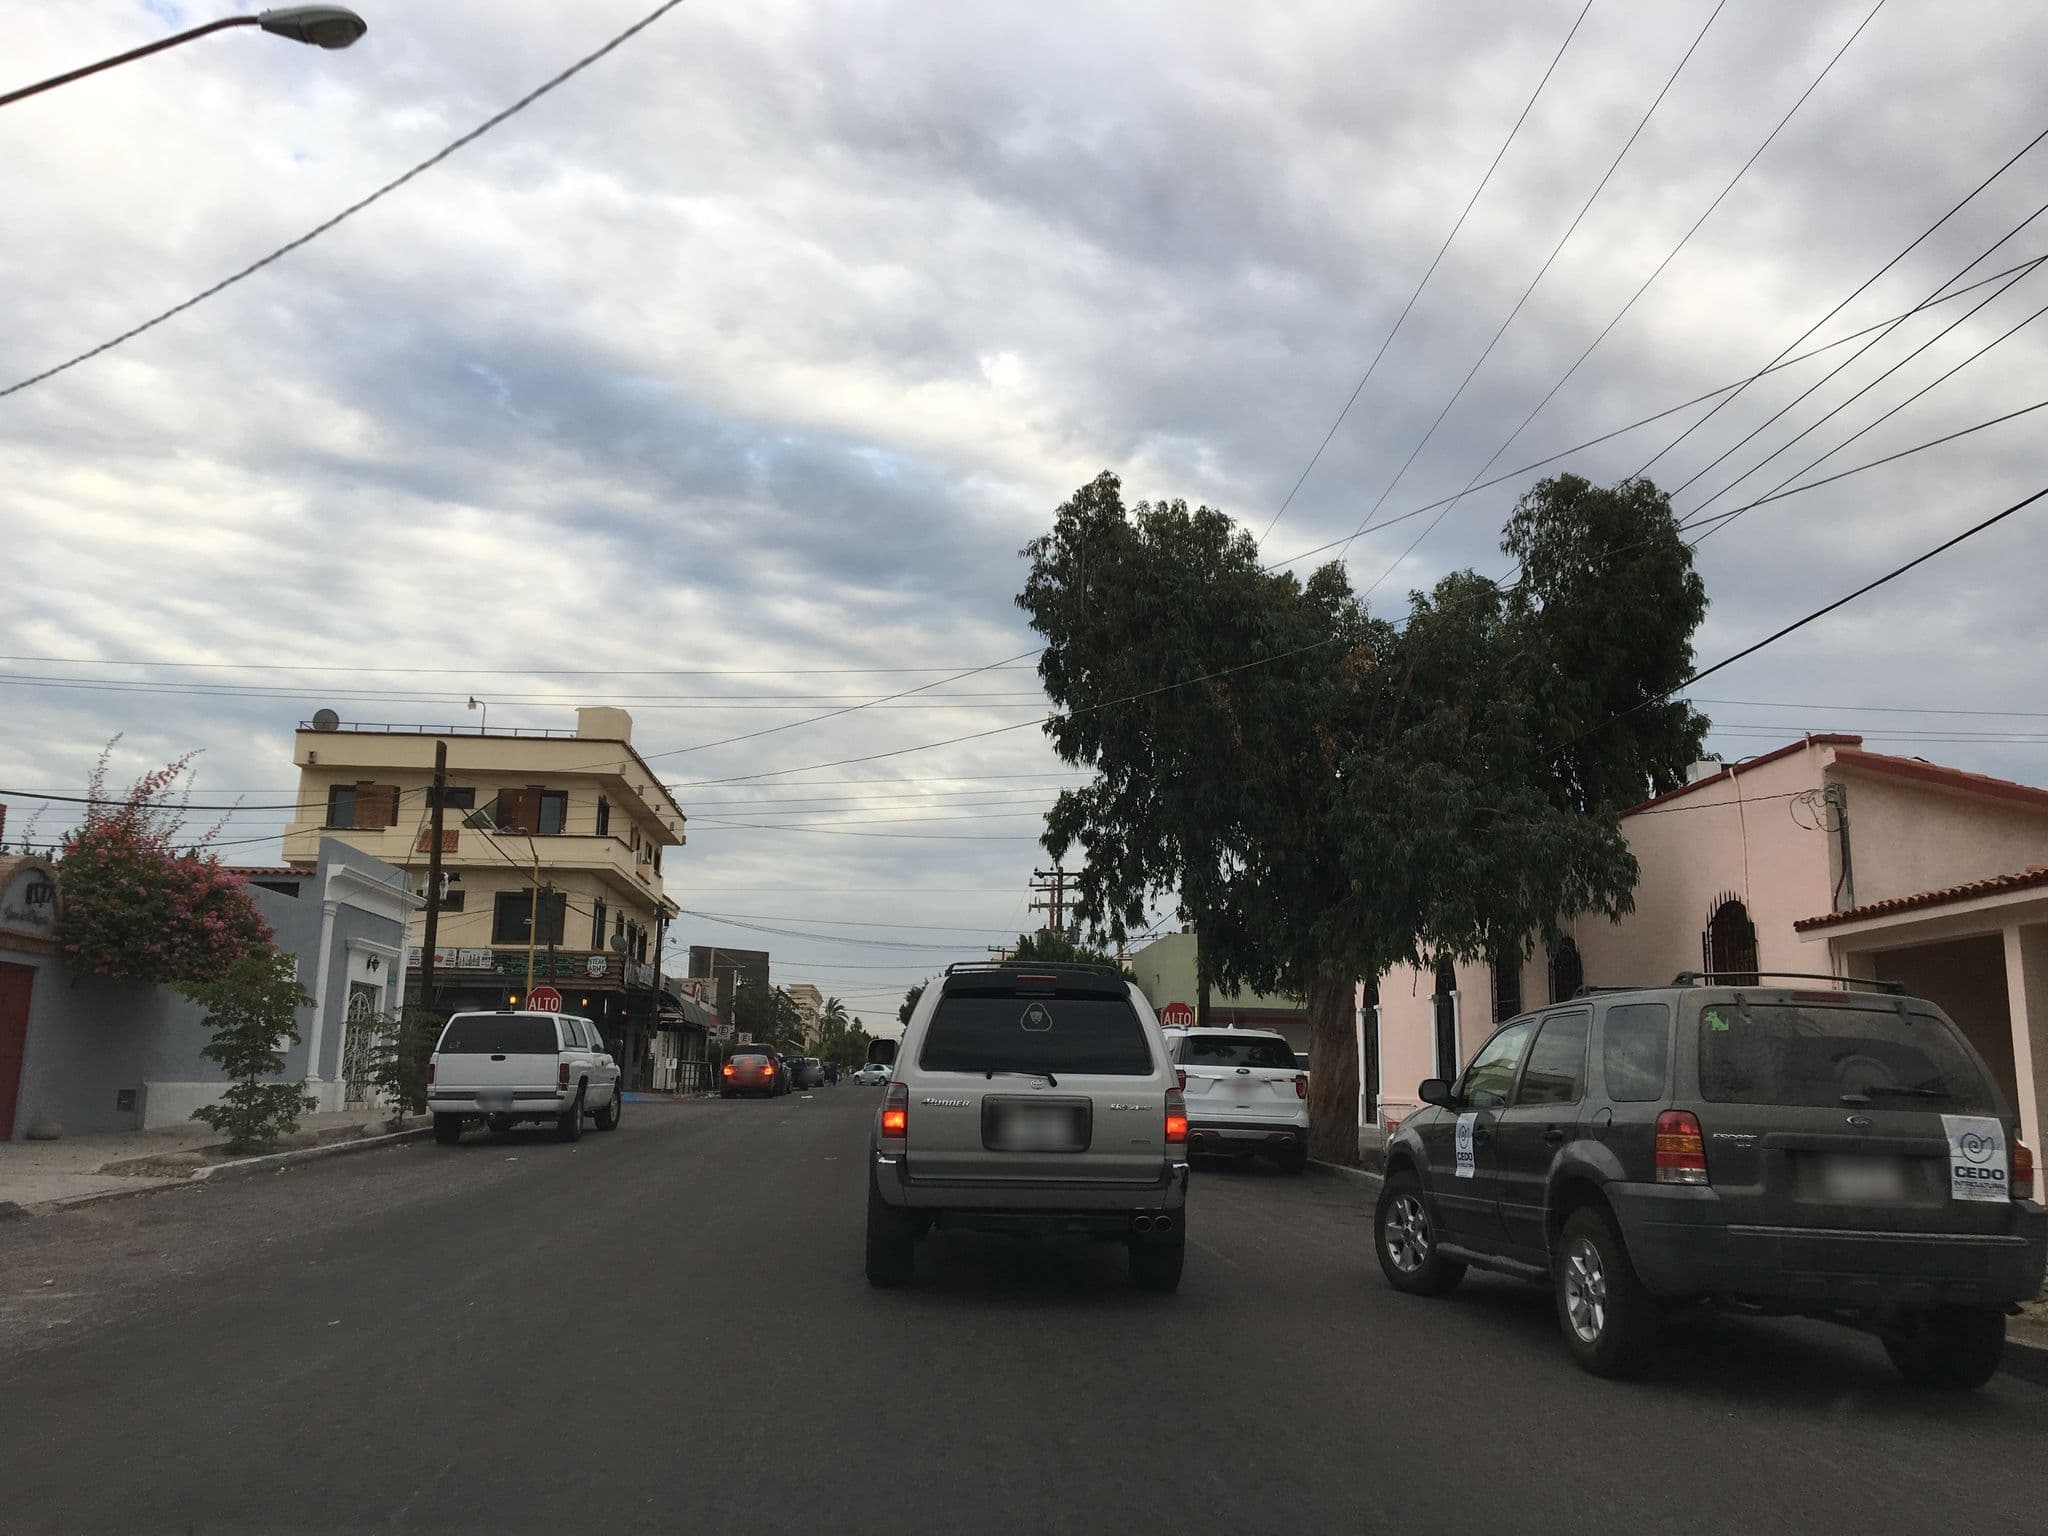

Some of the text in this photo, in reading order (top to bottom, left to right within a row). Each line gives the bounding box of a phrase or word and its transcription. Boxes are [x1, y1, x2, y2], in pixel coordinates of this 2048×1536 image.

[528, 997, 559, 1011] ALTO
[1163, 1012, 1191, 1026] ALTO
[1457, 1152, 1473, 1161] CEDO
[1954, 1166, 2005, 1181] CEDO
